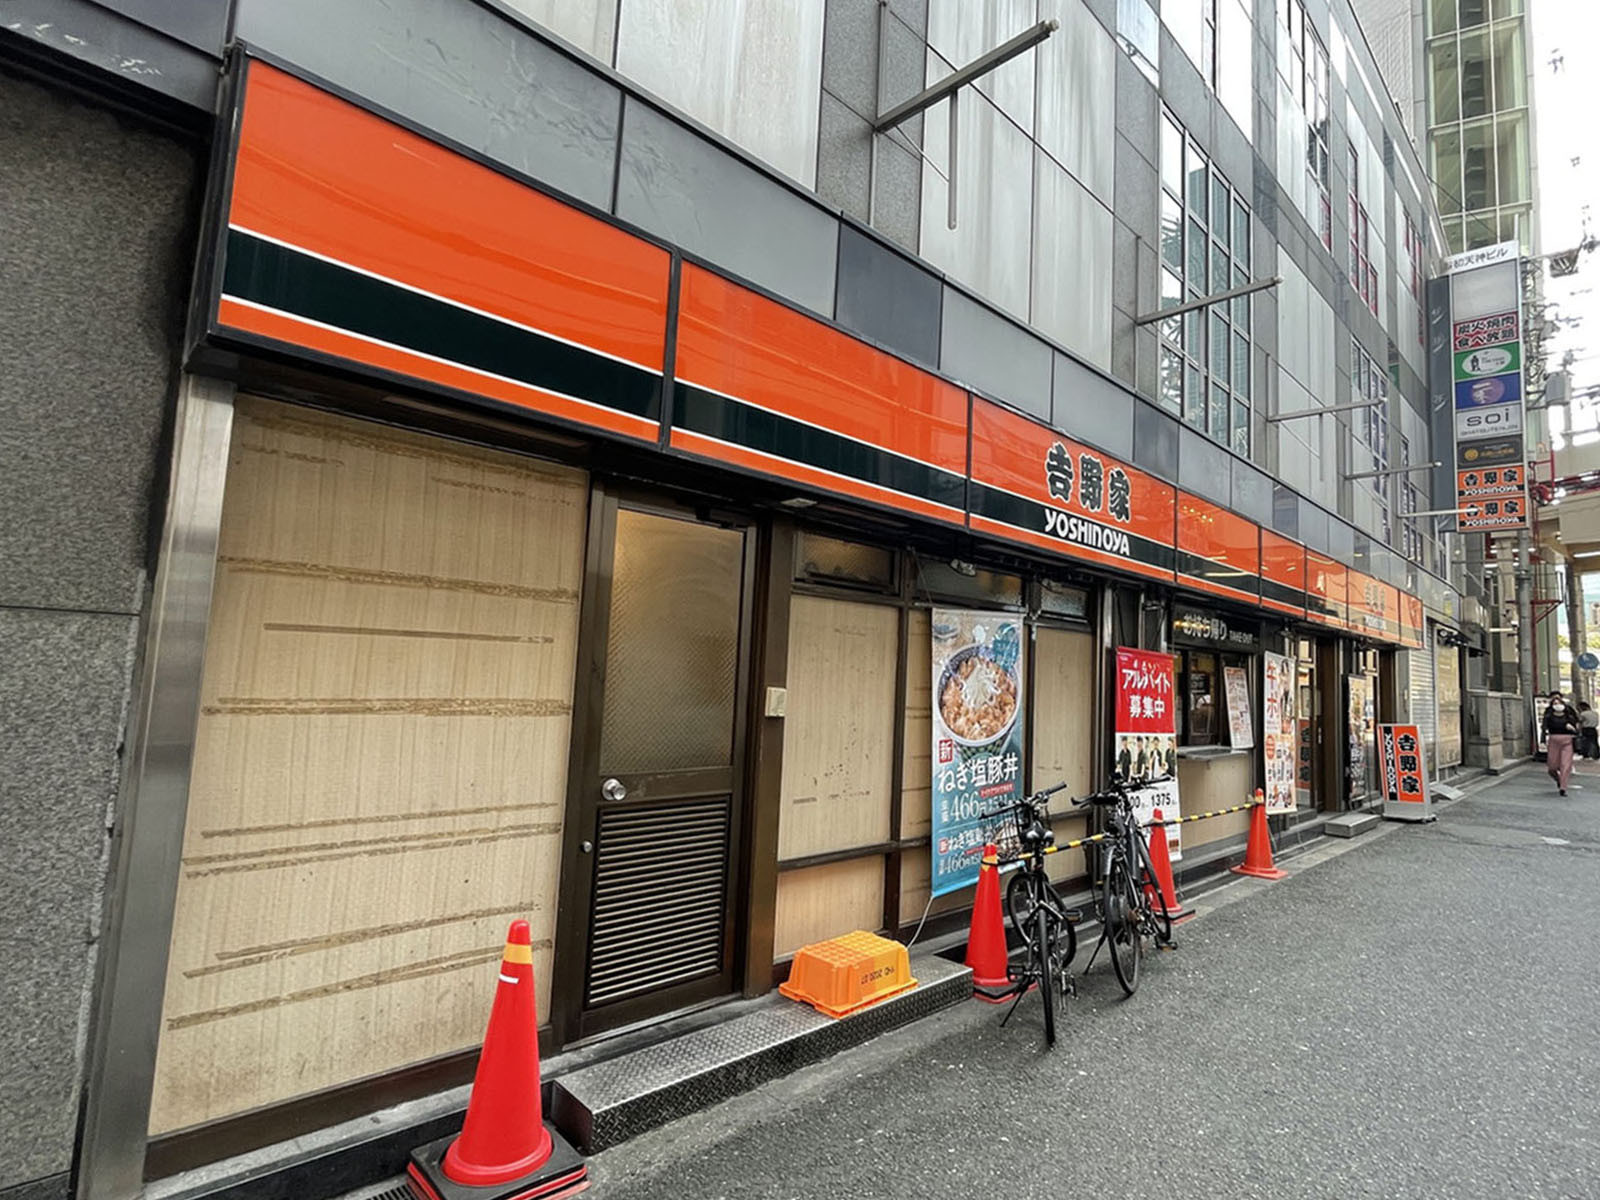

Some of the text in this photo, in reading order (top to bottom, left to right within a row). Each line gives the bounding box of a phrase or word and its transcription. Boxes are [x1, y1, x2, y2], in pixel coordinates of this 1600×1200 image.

[1045, 441, 1131, 523] 吉野家
[1464, 469, 1518, 487] 吉野家
[1045, 509, 1130, 556] YOSHINOYA
[1122, 665, 1171, 694] アルバイト
[1129, 694, 1165, 718] 募集中
[940, 740, 952, 762] 新
[1398, 733, 1421, 794] 吉野家
[938, 752, 1018, 793] ねぎ塩豚丼
[1151, 792, 1171, 807] 1375
